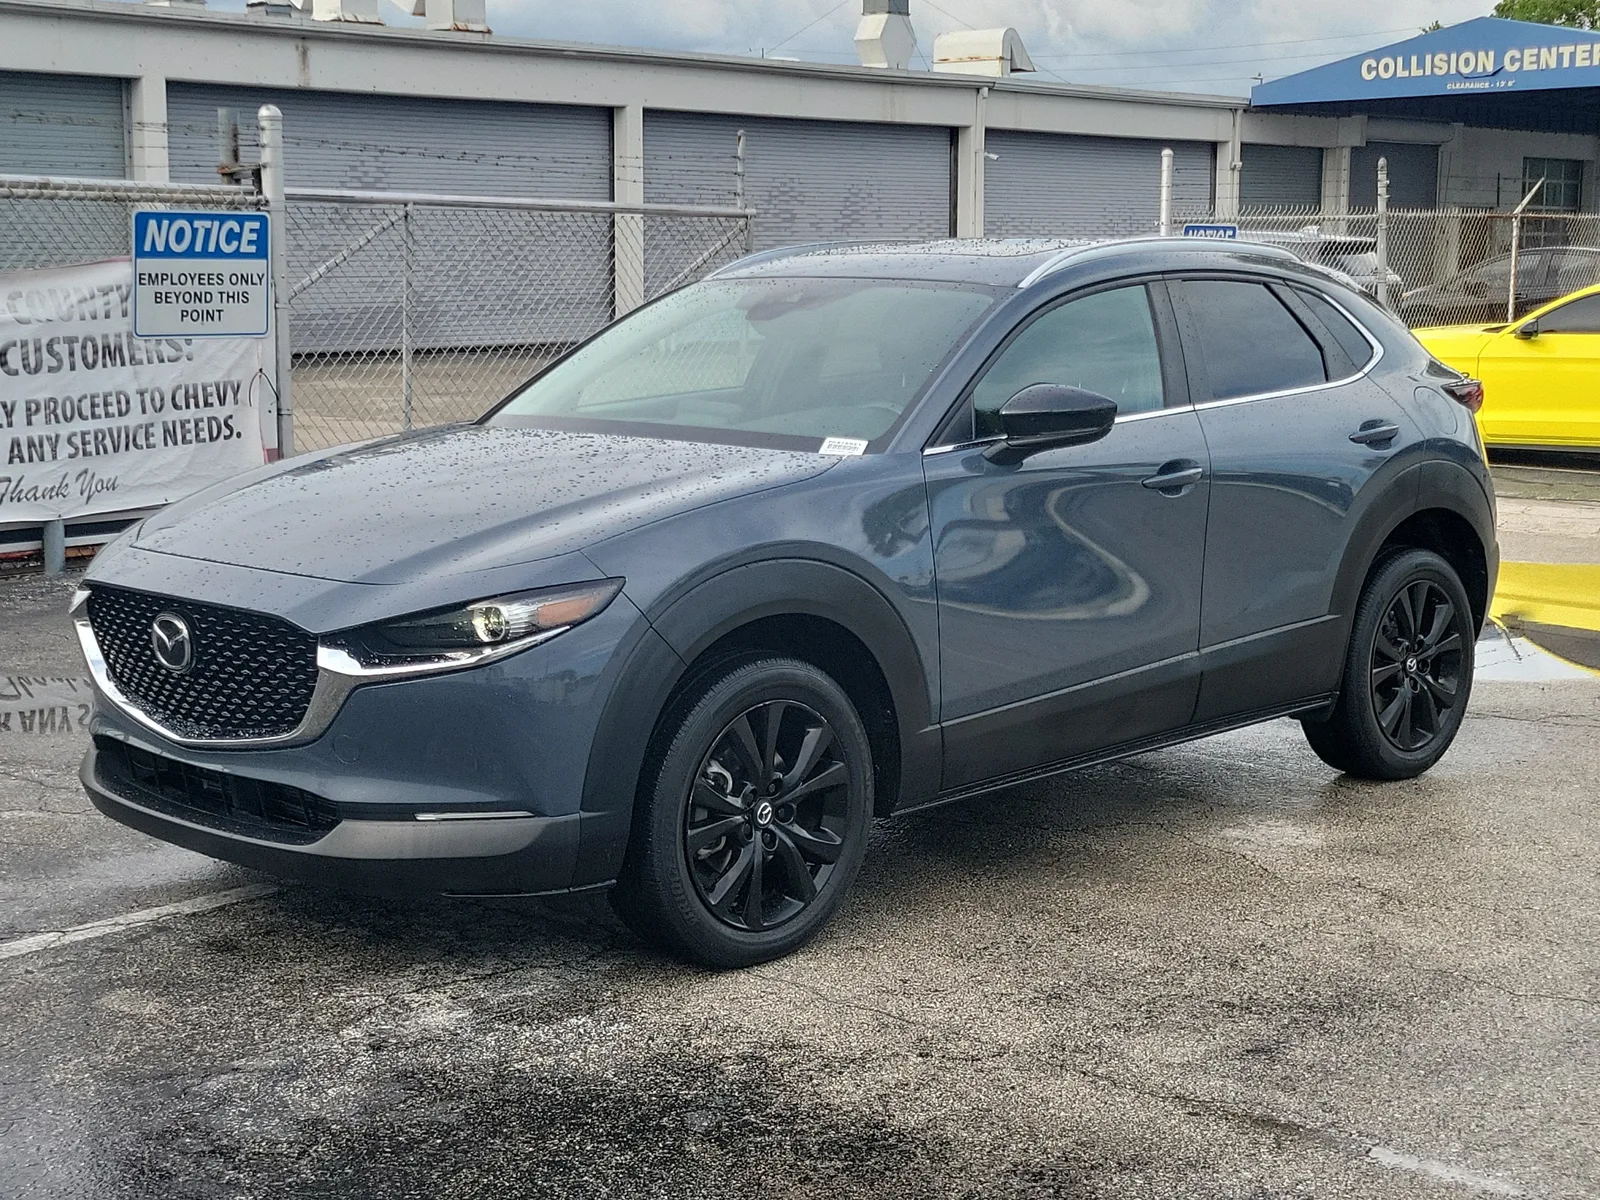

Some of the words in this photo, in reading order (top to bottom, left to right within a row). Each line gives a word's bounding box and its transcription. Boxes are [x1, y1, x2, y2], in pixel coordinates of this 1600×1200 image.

[1361, 50, 1495, 81] COLLISION
[1446, 81, 1490, 90] CLEARANCE
[144, 218, 261, 254] NOTICE
[138, 272, 225, 286] EMPLOYEES
[229, 273, 265, 286] ONLY
[154, 291, 213, 304] BEYOND
[218, 291, 249, 304] THIS
[180, 309, 224, 323] POINT
[25, 389, 132, 427] PROCEED
[136, 386, 165, 415] TO
[171, 380, 242, 411] CHEVY
[8, 433, 60, 465] ANY
[67, 422, 156, 459] SERVICE
[162, 414, 242, 447] NEEDS.
[0, 472, 70, 506] Thank
[75, 467, 119, 505] You
